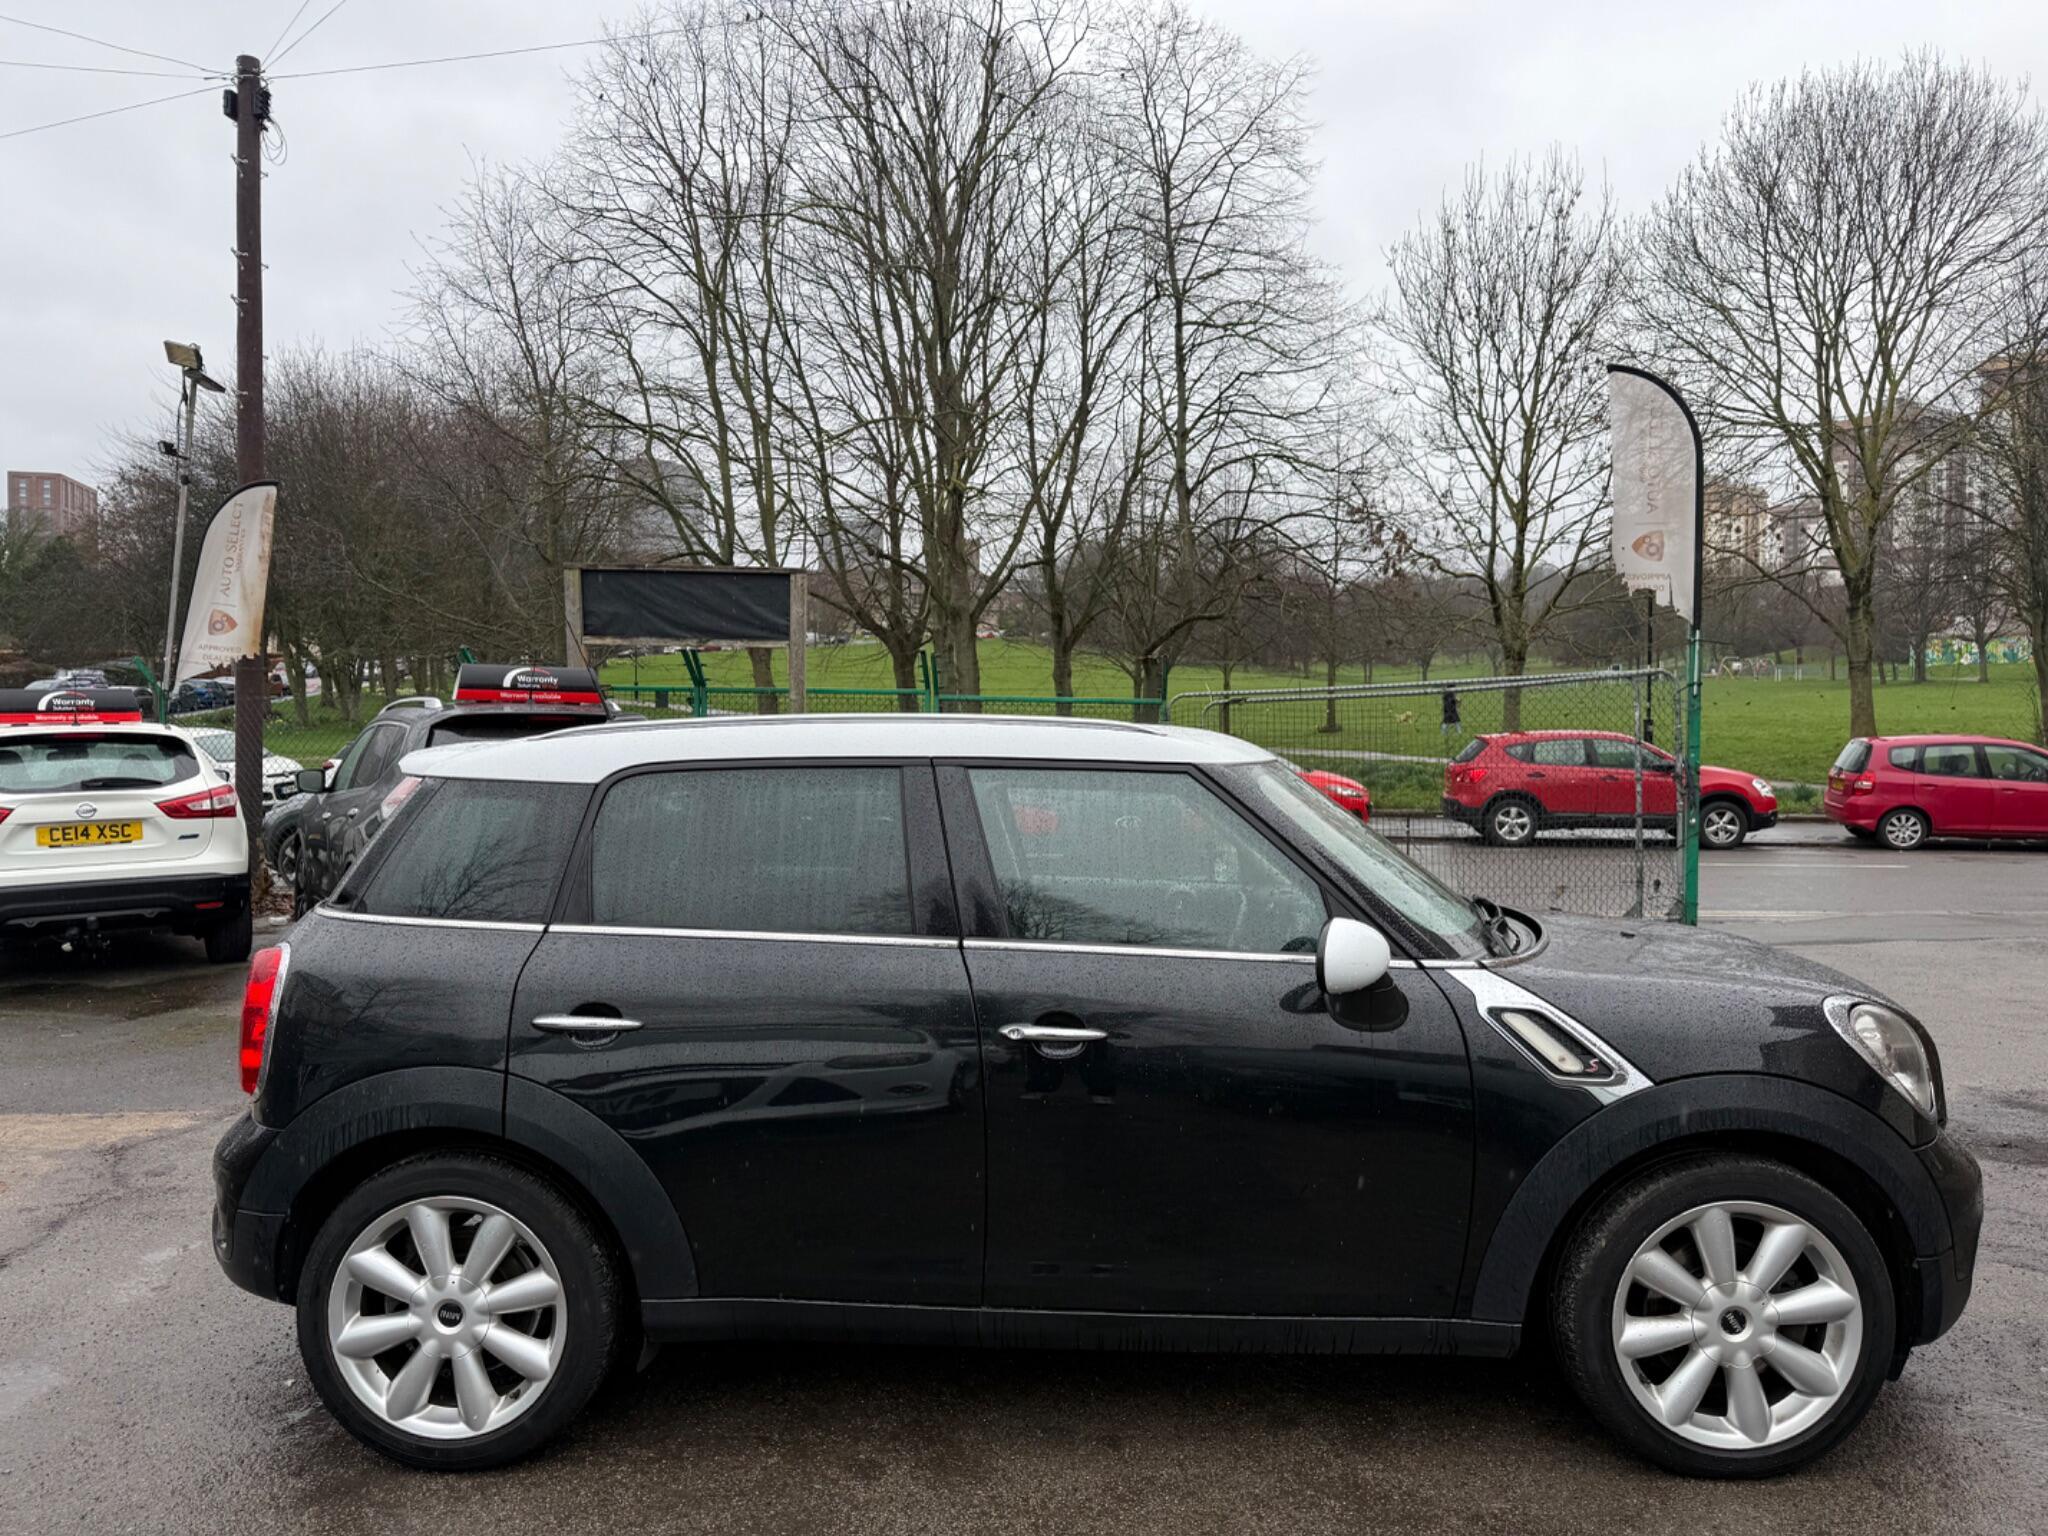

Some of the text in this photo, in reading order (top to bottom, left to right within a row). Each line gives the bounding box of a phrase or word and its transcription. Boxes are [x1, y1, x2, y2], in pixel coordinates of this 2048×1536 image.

[220, 501, 244, 597] AUTO SELECT
[198, 643, 242, 653] APPROVED
[517, 675, 559, 686] Warranty
[500, 692, 562, 700] Warranty available
[52, 698, 96, 707] Warranty
[49, 823, 132, 842] CE14 XSC
